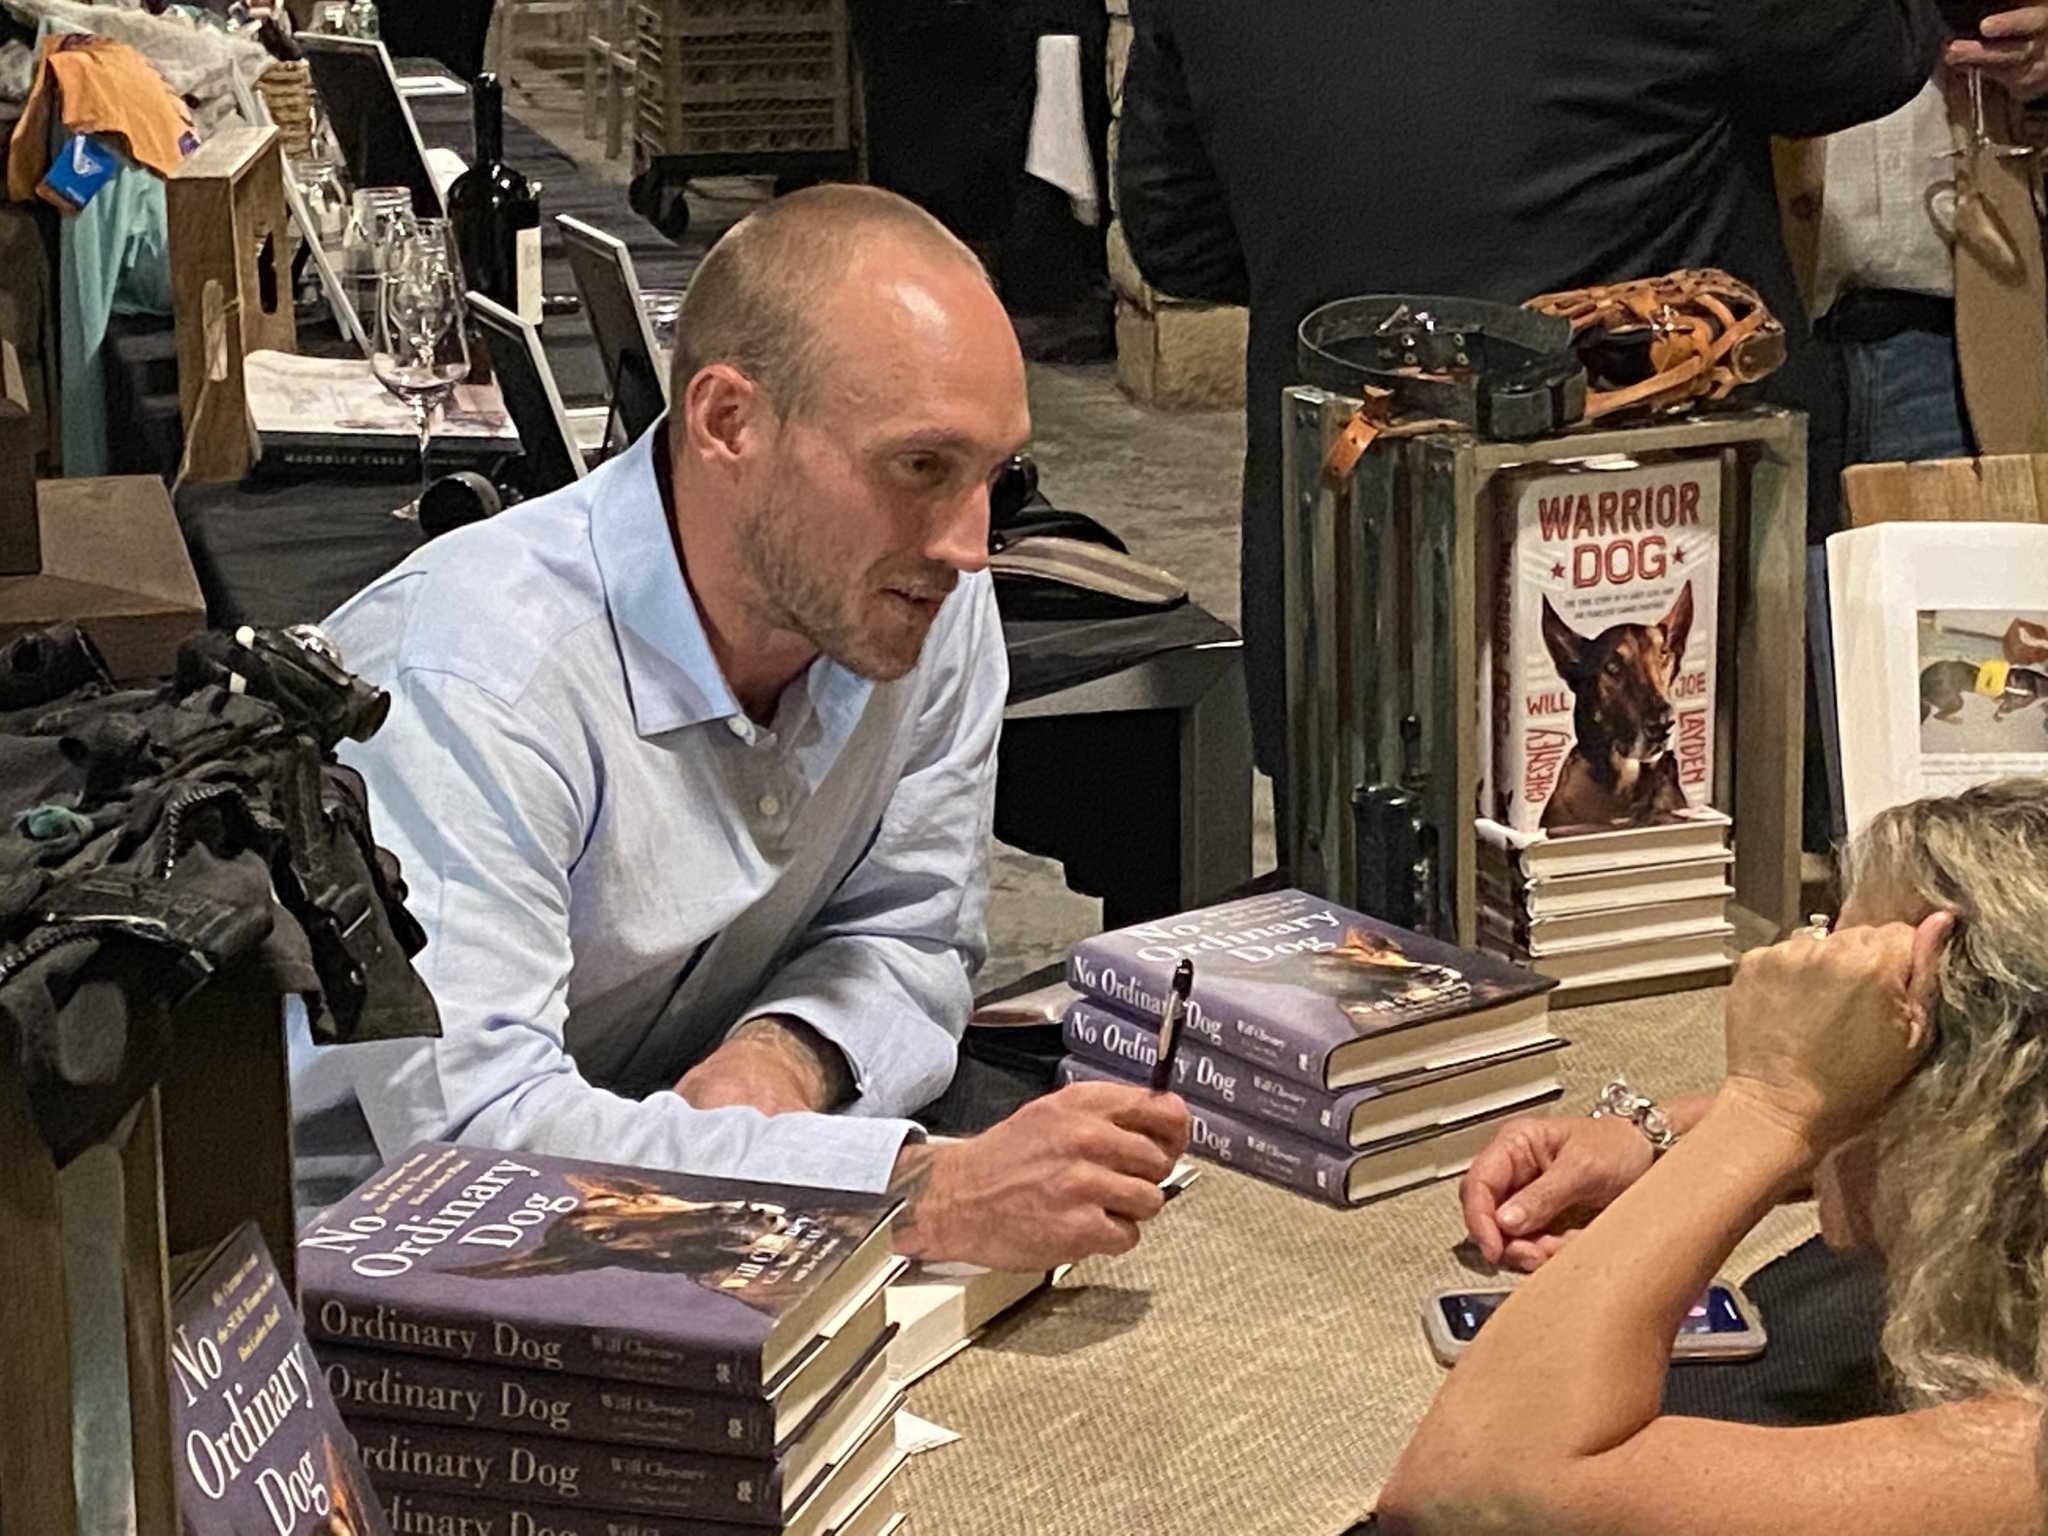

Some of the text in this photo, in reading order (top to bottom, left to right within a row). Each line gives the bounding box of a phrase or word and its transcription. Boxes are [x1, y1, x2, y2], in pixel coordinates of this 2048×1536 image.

[1538, 481, 1700, 542] WARRIOR
[1573, 536, 1667, 589] DOG
[1523, 690, 1572, 803] WILL CHESNEY
[1675, 672, 1707, 786] JOE LAYDEN
[1125, 923, 1201, 944] No
[1136, 909, 1340, 963] Ordinary
[1226, 935, 1338, 963] Dog
[1072, 955, 1097, 987] No
[1185, 1001, 1224, 1046] Dog
[1070, 1011, 1098, 1045] No
[1102, 1024, 1190, 1083] Ordiny
[1196, 1056, 1237, 1101] Dog
[1191, 1115, 1233, 1161] Dog
[297, 1214, 388, 1254] No
[350, 1158, 542, 1278] Ordinary
[458, 1190, 580, 1250] Dog
[171, 1324, 222, 1408] No
[320, 1299, 477, 1357] Ordinary
[492, 1320, 563, 1370] Dog
[186, 1342, 314, 1500] Ordinary
[324, 1362, 483, 1421] Ordinary
[500, 1381, 571, 1432] Dog
[254, 1451, 330, 1536] Dog
[361, 1435, 493, 1489] rdinary
[509, 1447, 580, 1497] Dog
[384, 1495, 493, 1536] dinary
